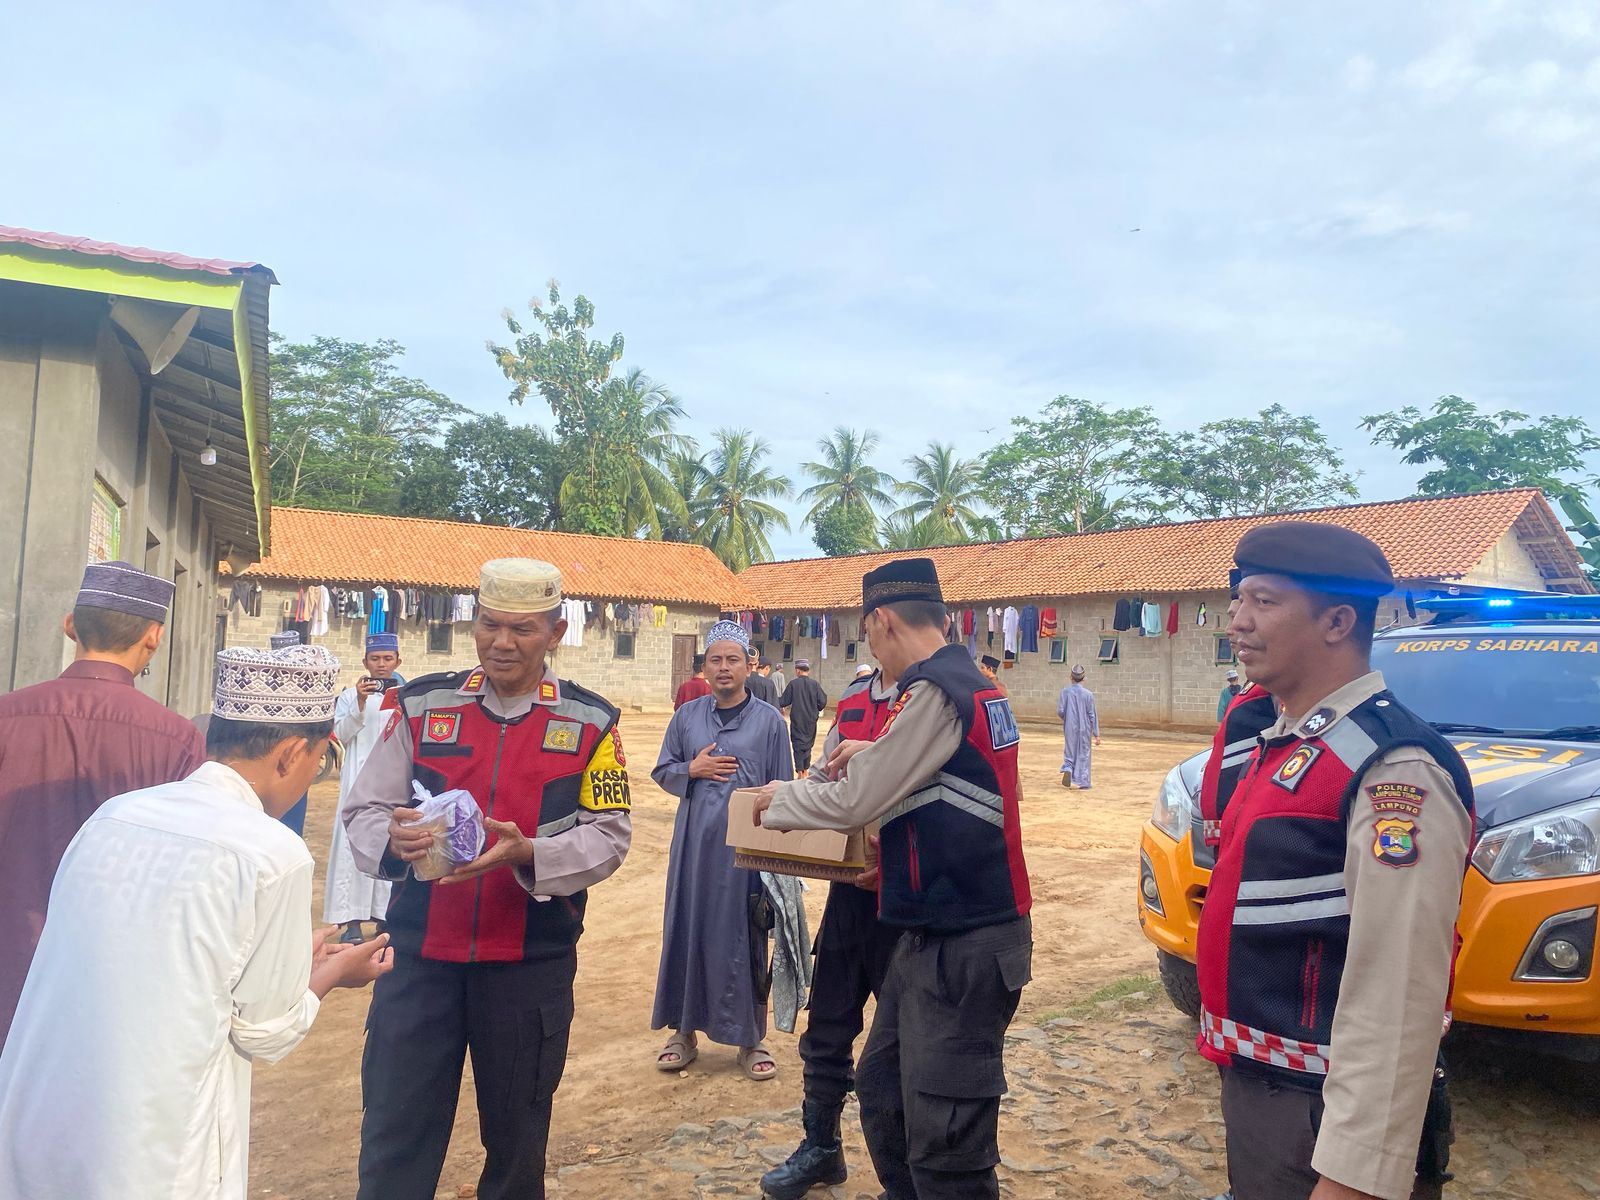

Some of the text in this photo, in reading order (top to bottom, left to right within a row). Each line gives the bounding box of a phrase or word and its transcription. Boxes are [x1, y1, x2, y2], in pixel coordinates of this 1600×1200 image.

[1395, 639, 1599, 653] KORPS SABHARA
[1376, 784, 1417, 793] POLRES
